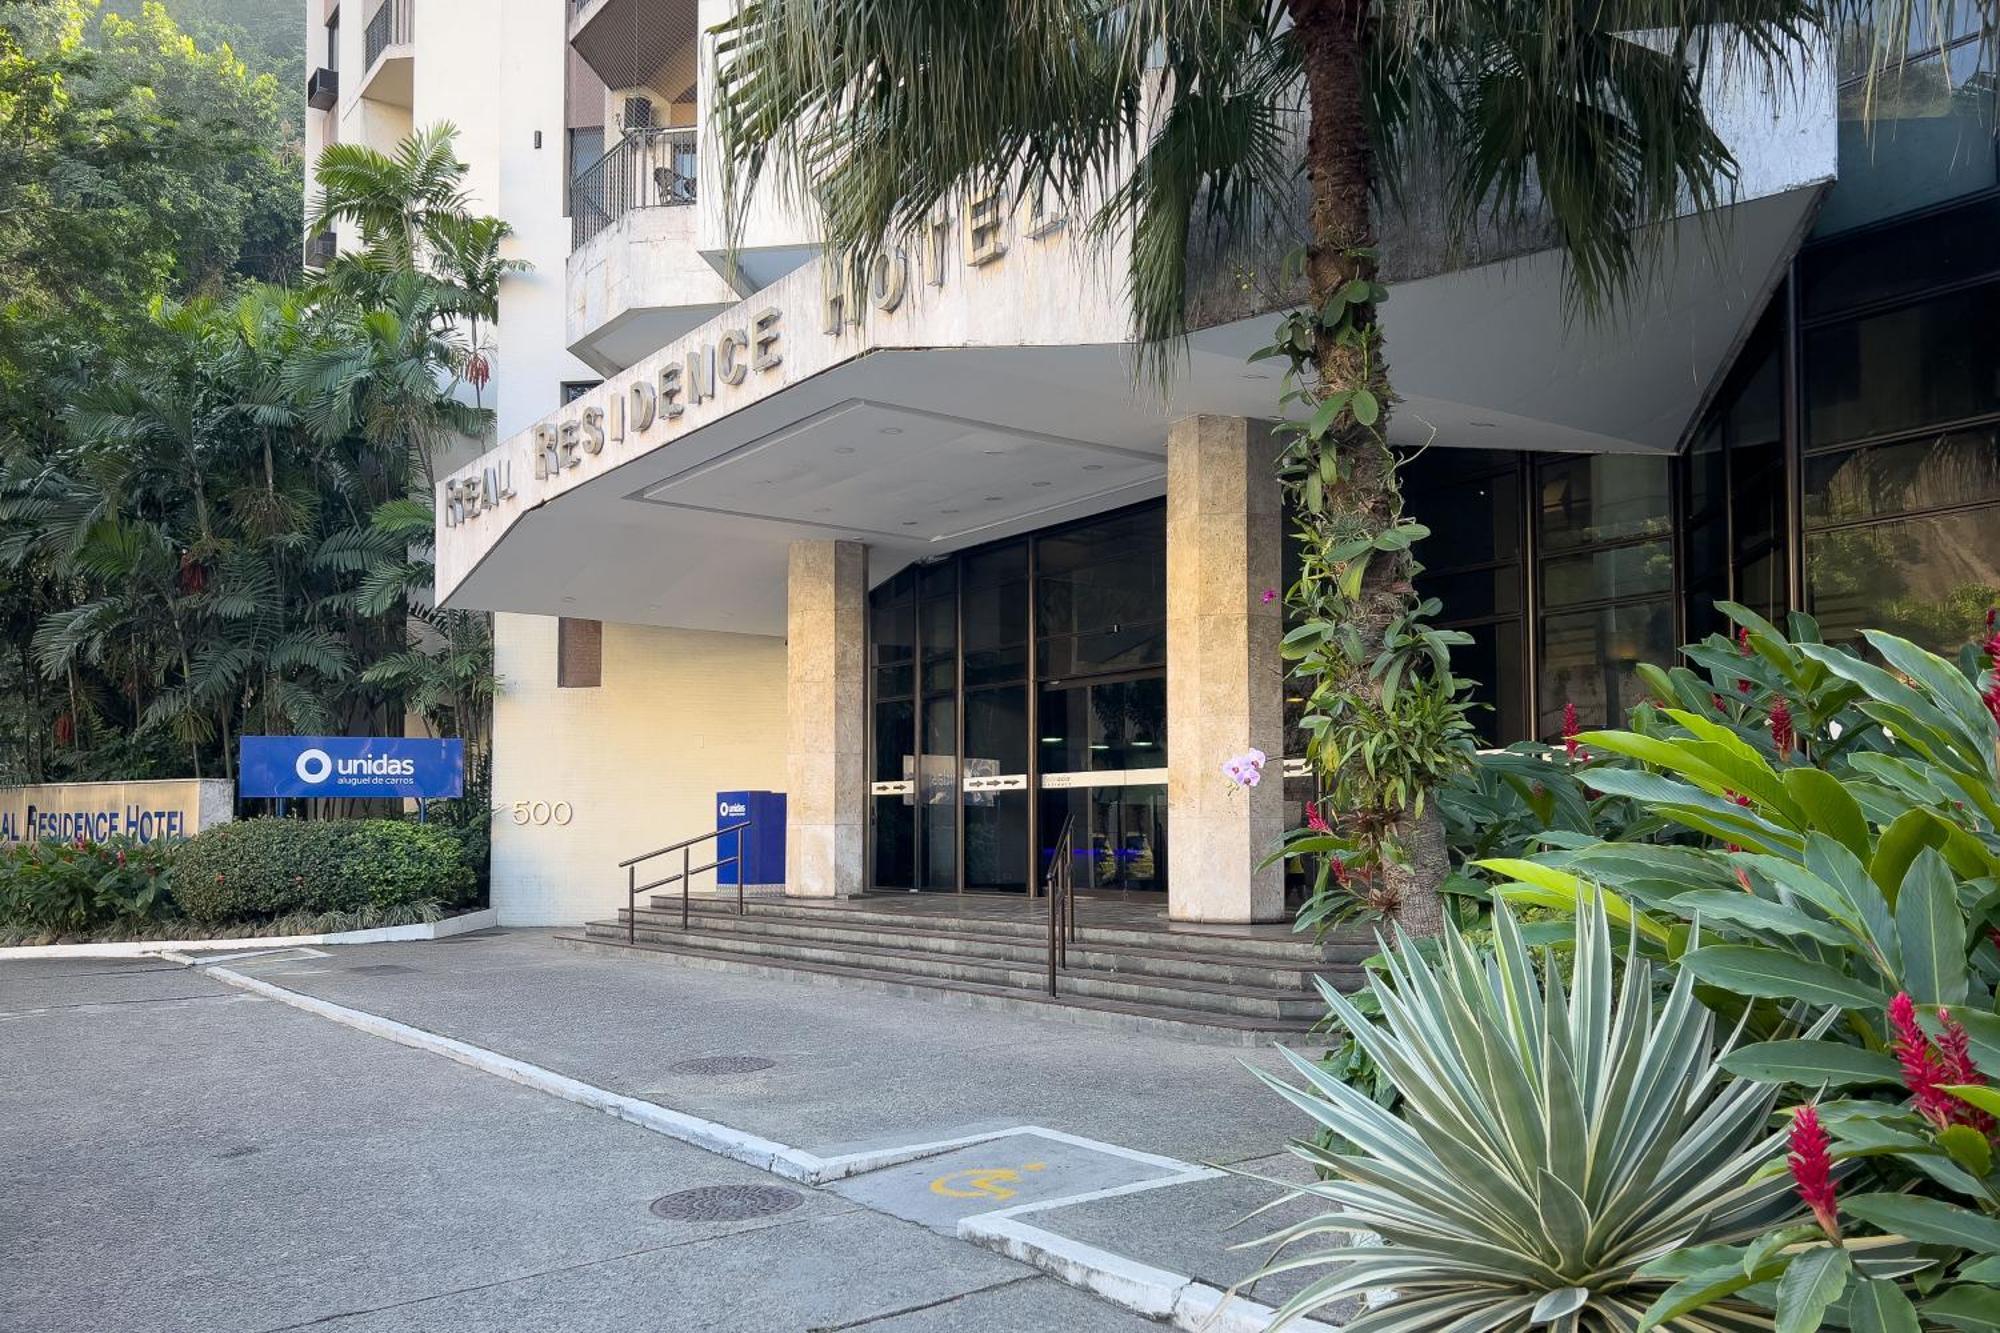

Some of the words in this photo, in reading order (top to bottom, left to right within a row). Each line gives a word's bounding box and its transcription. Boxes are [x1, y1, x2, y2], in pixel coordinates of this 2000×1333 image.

[446, 458, 517, 528] REAL
[535, 306, 783, 481] RESIDENCE
[337, 753, 415, 775] unidas
[337, 776, 371, 786] aluguel
[372, 776, 385, 785] de
[385, 777, 415, 785] carros
[26, 804, 120, 844] RESIDENCE
[513, 800, 573, 826] 500
